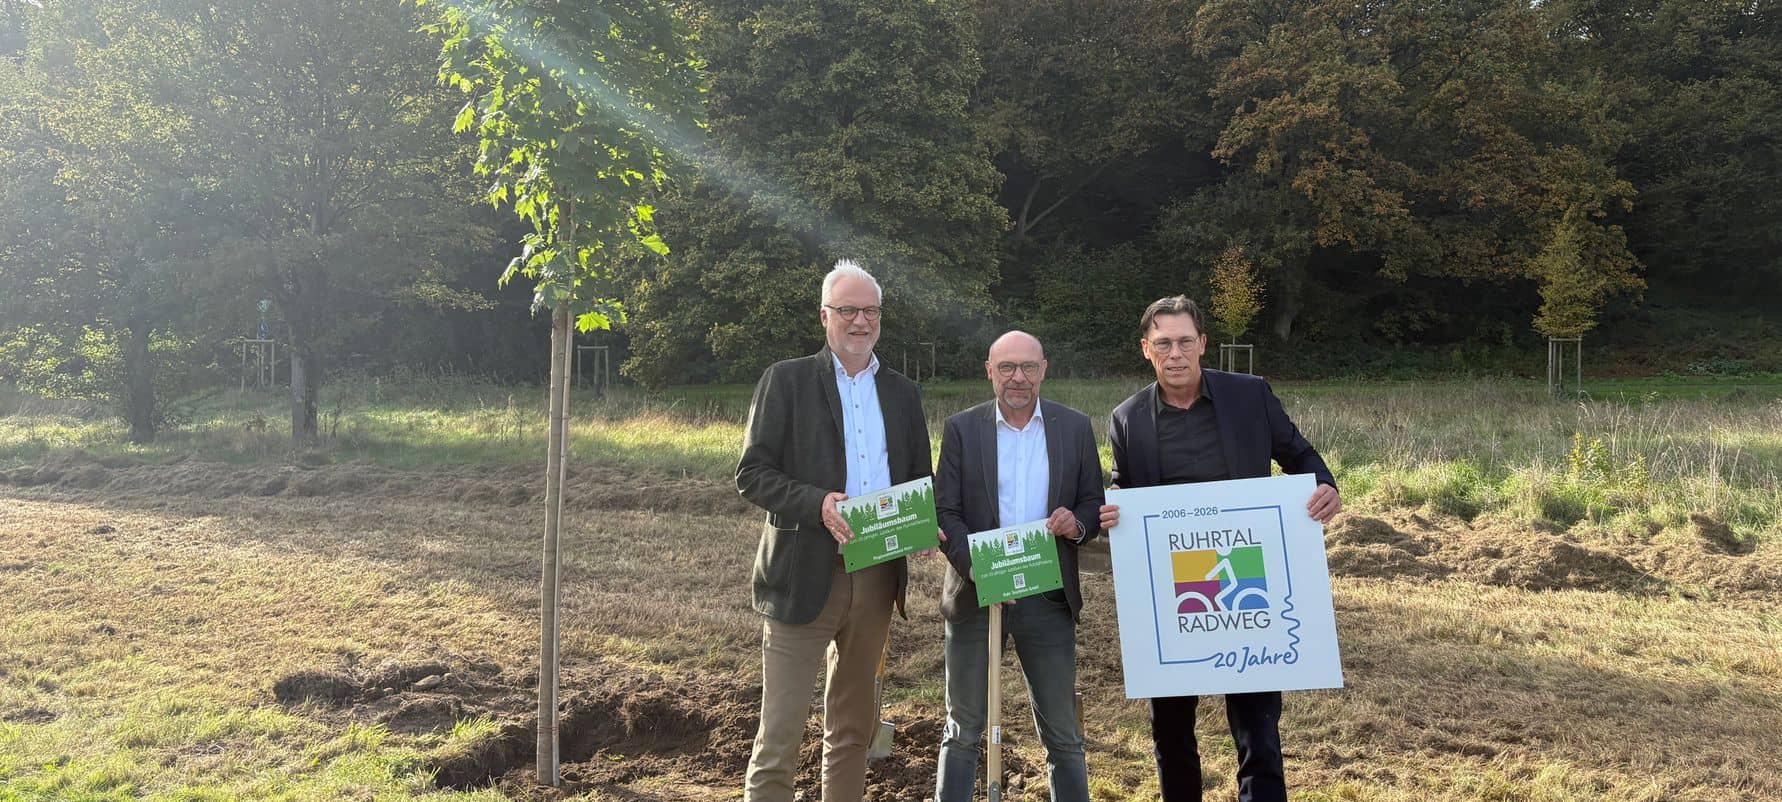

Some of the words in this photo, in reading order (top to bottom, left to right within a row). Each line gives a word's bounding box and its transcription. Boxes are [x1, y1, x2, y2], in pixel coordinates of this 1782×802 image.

[860, 513, 918, 535] Jubiläumsbaum
[1168, 528, 1262, 550] RUHRTAL
[990, 553, 1042, 570] Jubiläumsbaum
[1178, 610, 1272, 633] RADWEG
[1214, 651, 1237, 668] 20
[1237, 646, 1297, 673] Jahre
